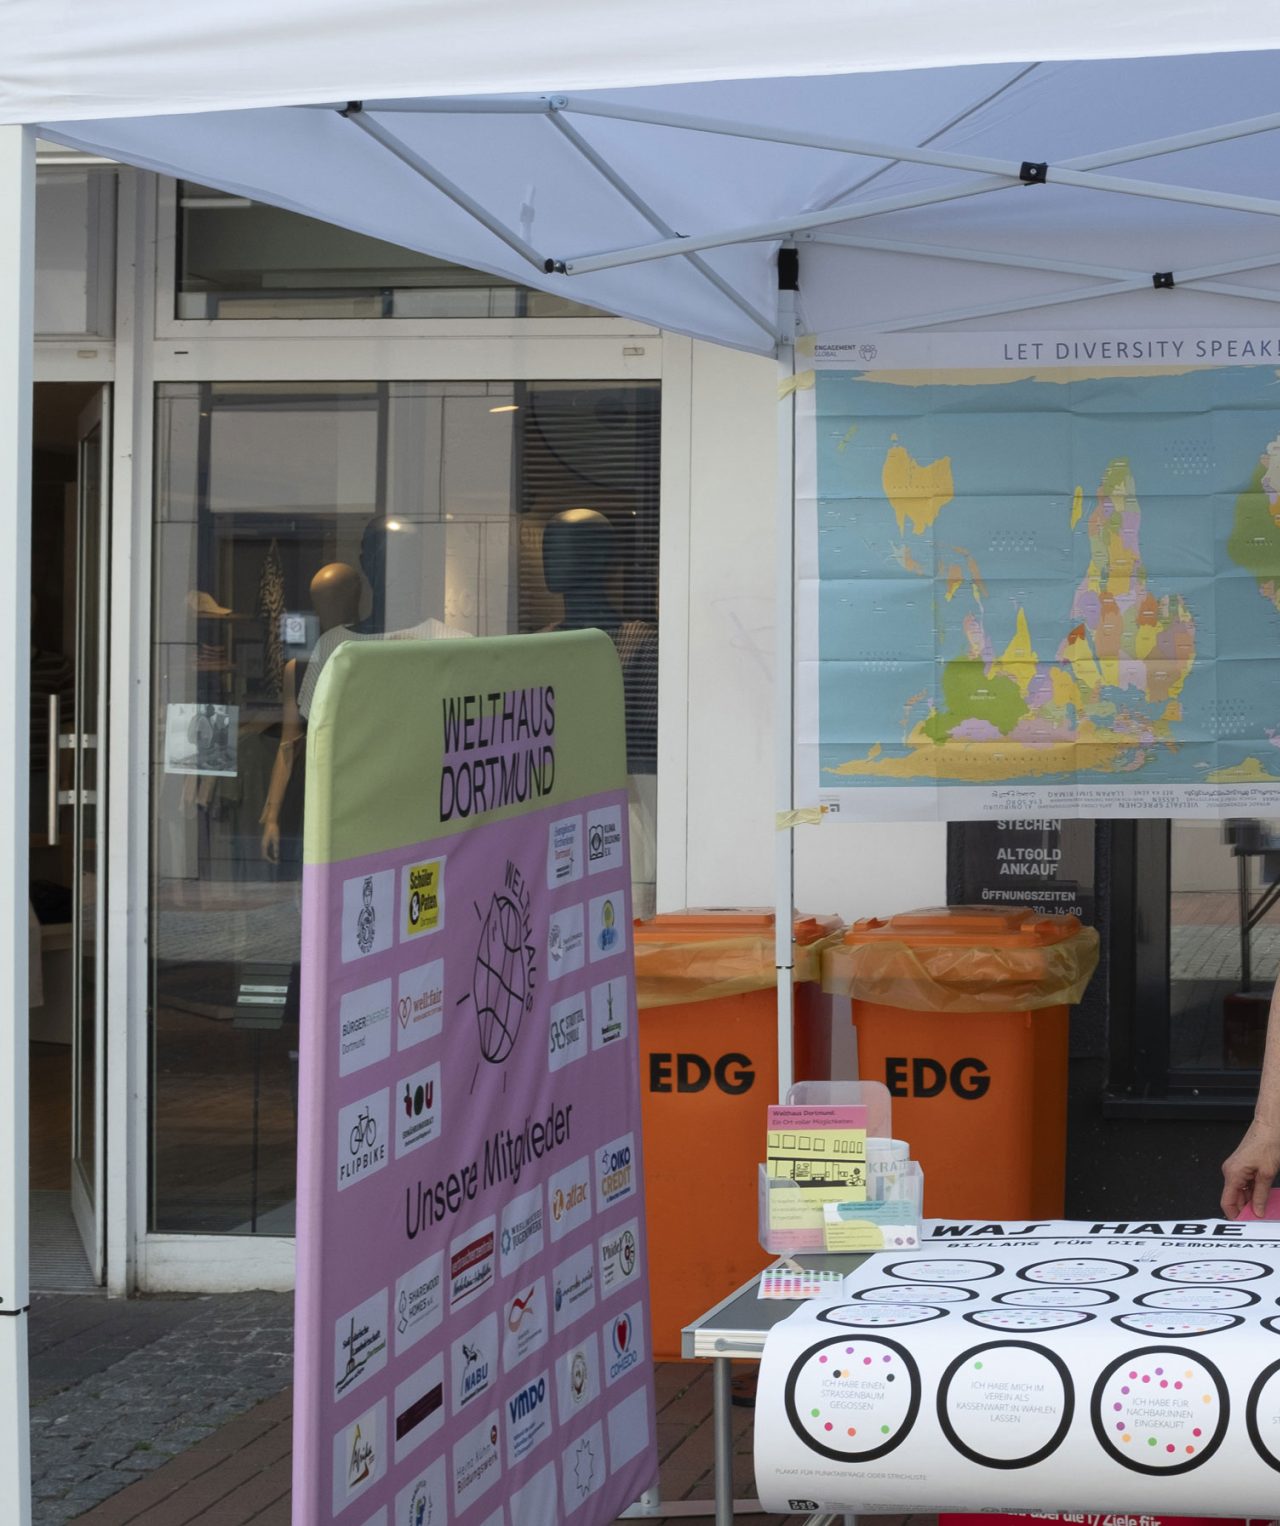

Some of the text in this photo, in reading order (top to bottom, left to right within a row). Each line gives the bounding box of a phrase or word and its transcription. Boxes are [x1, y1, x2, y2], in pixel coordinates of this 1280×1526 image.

[1004, 343, 1043, 360] LET
[1056, 341, 1184, 360] DIVERSITY
[442, 686, 556, 754] WELTHAUS
[440, 745, 556, 822] DORTMUND
[996, 819, 1062, 831] STECHEN
[997, 848, 1062, 861] ALTGOLD
[1000, 863, 1058, 876] ANKAUF
[982, 888, 1076, 902] ÖFFNUNGSZEITEN
[504, 859, 536, 1012] WELTHAUS
[649, 1052, 755, 1094] EDG
[885, 1057, 991, 1100] EDG
[340, 1144, 385, 1180] FLIPBIKE
[611, 1146, 631, 1171] OIKO
[406, 1103, 573, 1239] Unsere Mitglieder
[602, 1167, 631, 1195] CREDIT
[932, 1224, 1051, 1237] WAS
[1088, 1223, 1246, 1237] HABE
[947, 1240, 1040, 1248] BISLANG
[409, 1275, 440, 1304] SHAREWOOD
[610, 1350, 637, 1379] COHEDO
[464, 1362, 489, 1394] NABU
[822, 1380, 886, 1390] ICH HABE EINEN
[971, 1381, 1045, 1392] ICH HABE MICH IM
[510, 1377, 545, 1424] VMDO
[820, 1390, 885, 1401] STRASSENBAUM
[984, 1392, 1030, 1402] VEREIN ALS
[1132, 1397, 1189, 1408] ICH HABE FÜR
[829, 1400, 875, 1411] GEGOSSEN
[990, 1414, 1021, 1424] LASSEN
[1134, 1419, 1185, 1430] EINGEKAUFT
